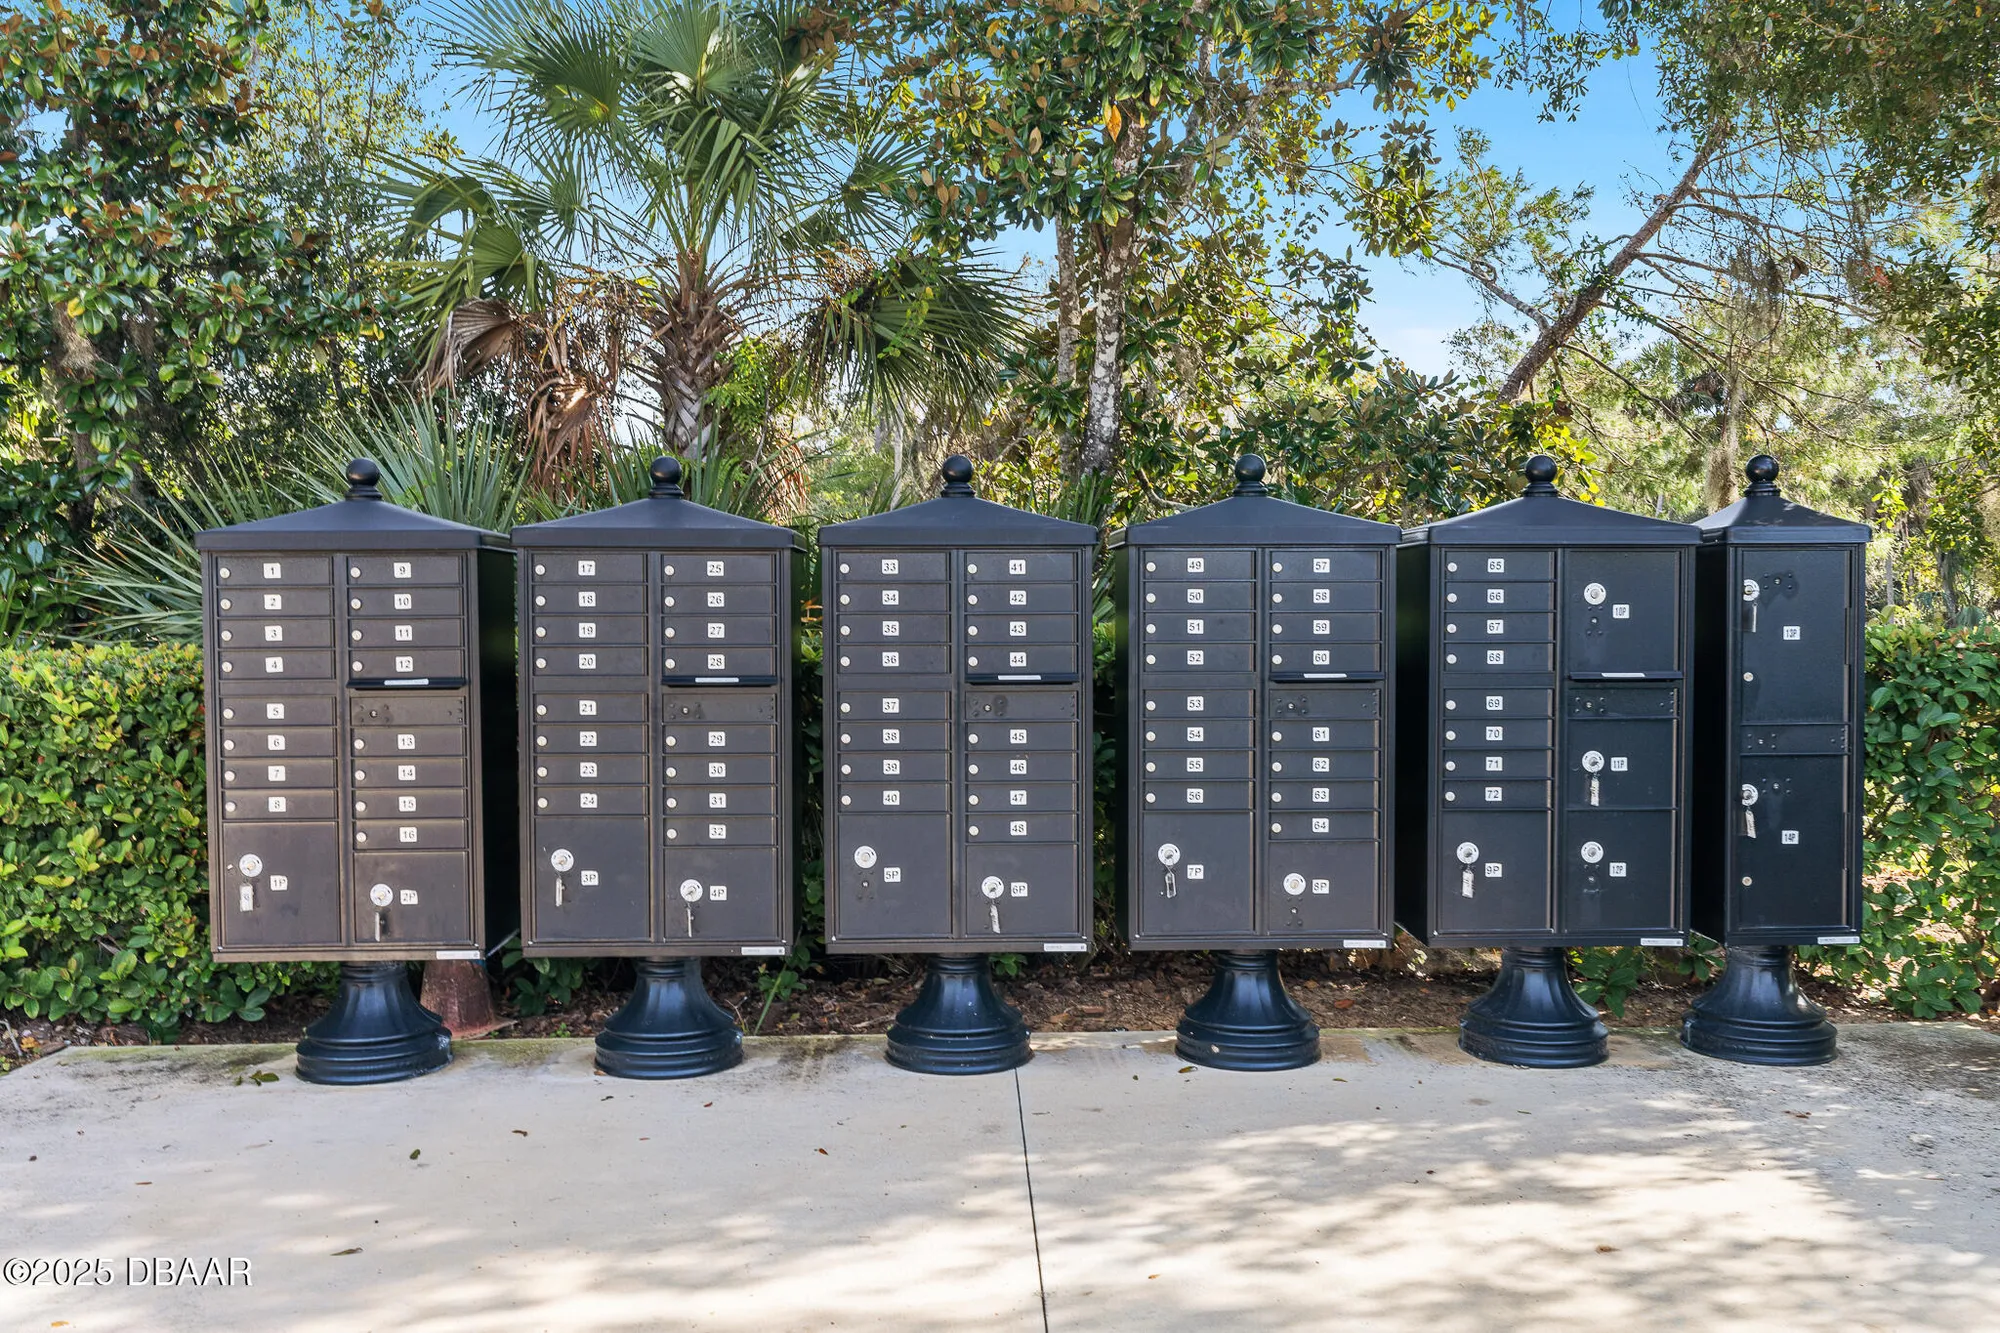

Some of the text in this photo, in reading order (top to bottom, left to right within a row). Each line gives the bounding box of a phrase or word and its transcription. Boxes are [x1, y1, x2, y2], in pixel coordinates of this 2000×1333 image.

[398, 565, 406, 575] 9
[581, 563, 593, 573] 17
[708, 564, 722, 574] 25
[883, 562, 897, 572] 33
[1010, 562, 1023, 572] 41
[1188, 560, 1202, 570] 49
[1315, 561, 1328, 571] 57
[1489, 561, 1502, 571] 65
[270, 566, 276, 576] 1
[582, 594, 594, 605] 18
[709, 595, 723, 605] 26
[883, 593, 897, 603] 34
[1011, 593, 1025, 603] 42
[1188, 591, 1202, 601] 50
[1488, 591, 1502, 602] 66
[269, 597, 276, 607] 2
[398, 596, 410, 607] 10
[581, 625, 594, 636] 19
[709, 625, 722, 636] 27
[884, 624, 898, 634] 35
[1011, 624, 1025, 634] 43
[1188, 622, 1201, 632] 51
[1315, 622, 1328, 632] 59
[1488, 622, 1501, 632] 67
[270, 629, 278, 639] 3
[399, 628, 410, 638] 11
[581, 656, 594, 667] 20
[709, 657, 723, 667] 28
[884, 654, 897, 665] 36
[1011, 655, 1024, 664] 44
[1188, 652, 1202, 663] 52
[1314, 653, 1328, 663] 60
[270, 660, 278, 671] 4
[399, 659, 411, 669] 12
[581, 703, 593, 713] 21
[884, 701, 897, 711] 37
[1188, 699, 1202, 709] 53
[1487, 698, 1501, 708] 69
[272, 707, 279, 717] 5
[582, 734, 595, 744] 22
[710, 734, 723, 744] 29
[884, 731, 898, 742] 38
[1011, 732, 1025, 742] 45
[1188, 729, 1202, 739] 54
[1314, 729, 1326, 739] 61
[1487, 729, 1500, 739] 70
[273, 738, 280, 748] 6
[401, 737, 413, 747] 13
[884, 762, 898, 773] 39
[1011, 762, 1025, 772] 46
[1188, 760, 1202, 770] 55
[1314, 760, 1327, 770] 62
[1487, 759, 1499, 769] 71
[1613, 759, 1625, 769] 11P
[402, 768, 413, 778] 14
[582, 765, 595, 775] 23
[710, 765, 724, 775] 30
[884, 793, 898, 803] 40
[1011, 793, 1025, 803] 47
[1188, 791, 1201, 801] 56
[1314, 790, 1327, 800] 63
[1487, 789, 1500, 799] 72
[402, 799, 414, 809] 15
[582, 796, 595, 806] 24
[711, 796, 723, 806] 31
[1313, 820, 1327, 830] 64
[403, 830, 415, 839] 16
[711, 827, 724, 837] 32
[885, 870, 899, 880] 5P
[1188, 867, 1202, 877] 7P
[1486, 865, 1500, 875] 9P
[273, 878, 287, 888] 1P
[582, 873, 597, 883] 3P
[711, 888, 725, 898] 4P
[1012, 884, 1026, 895] 6P
[402, 892, 417, 902] 2P
